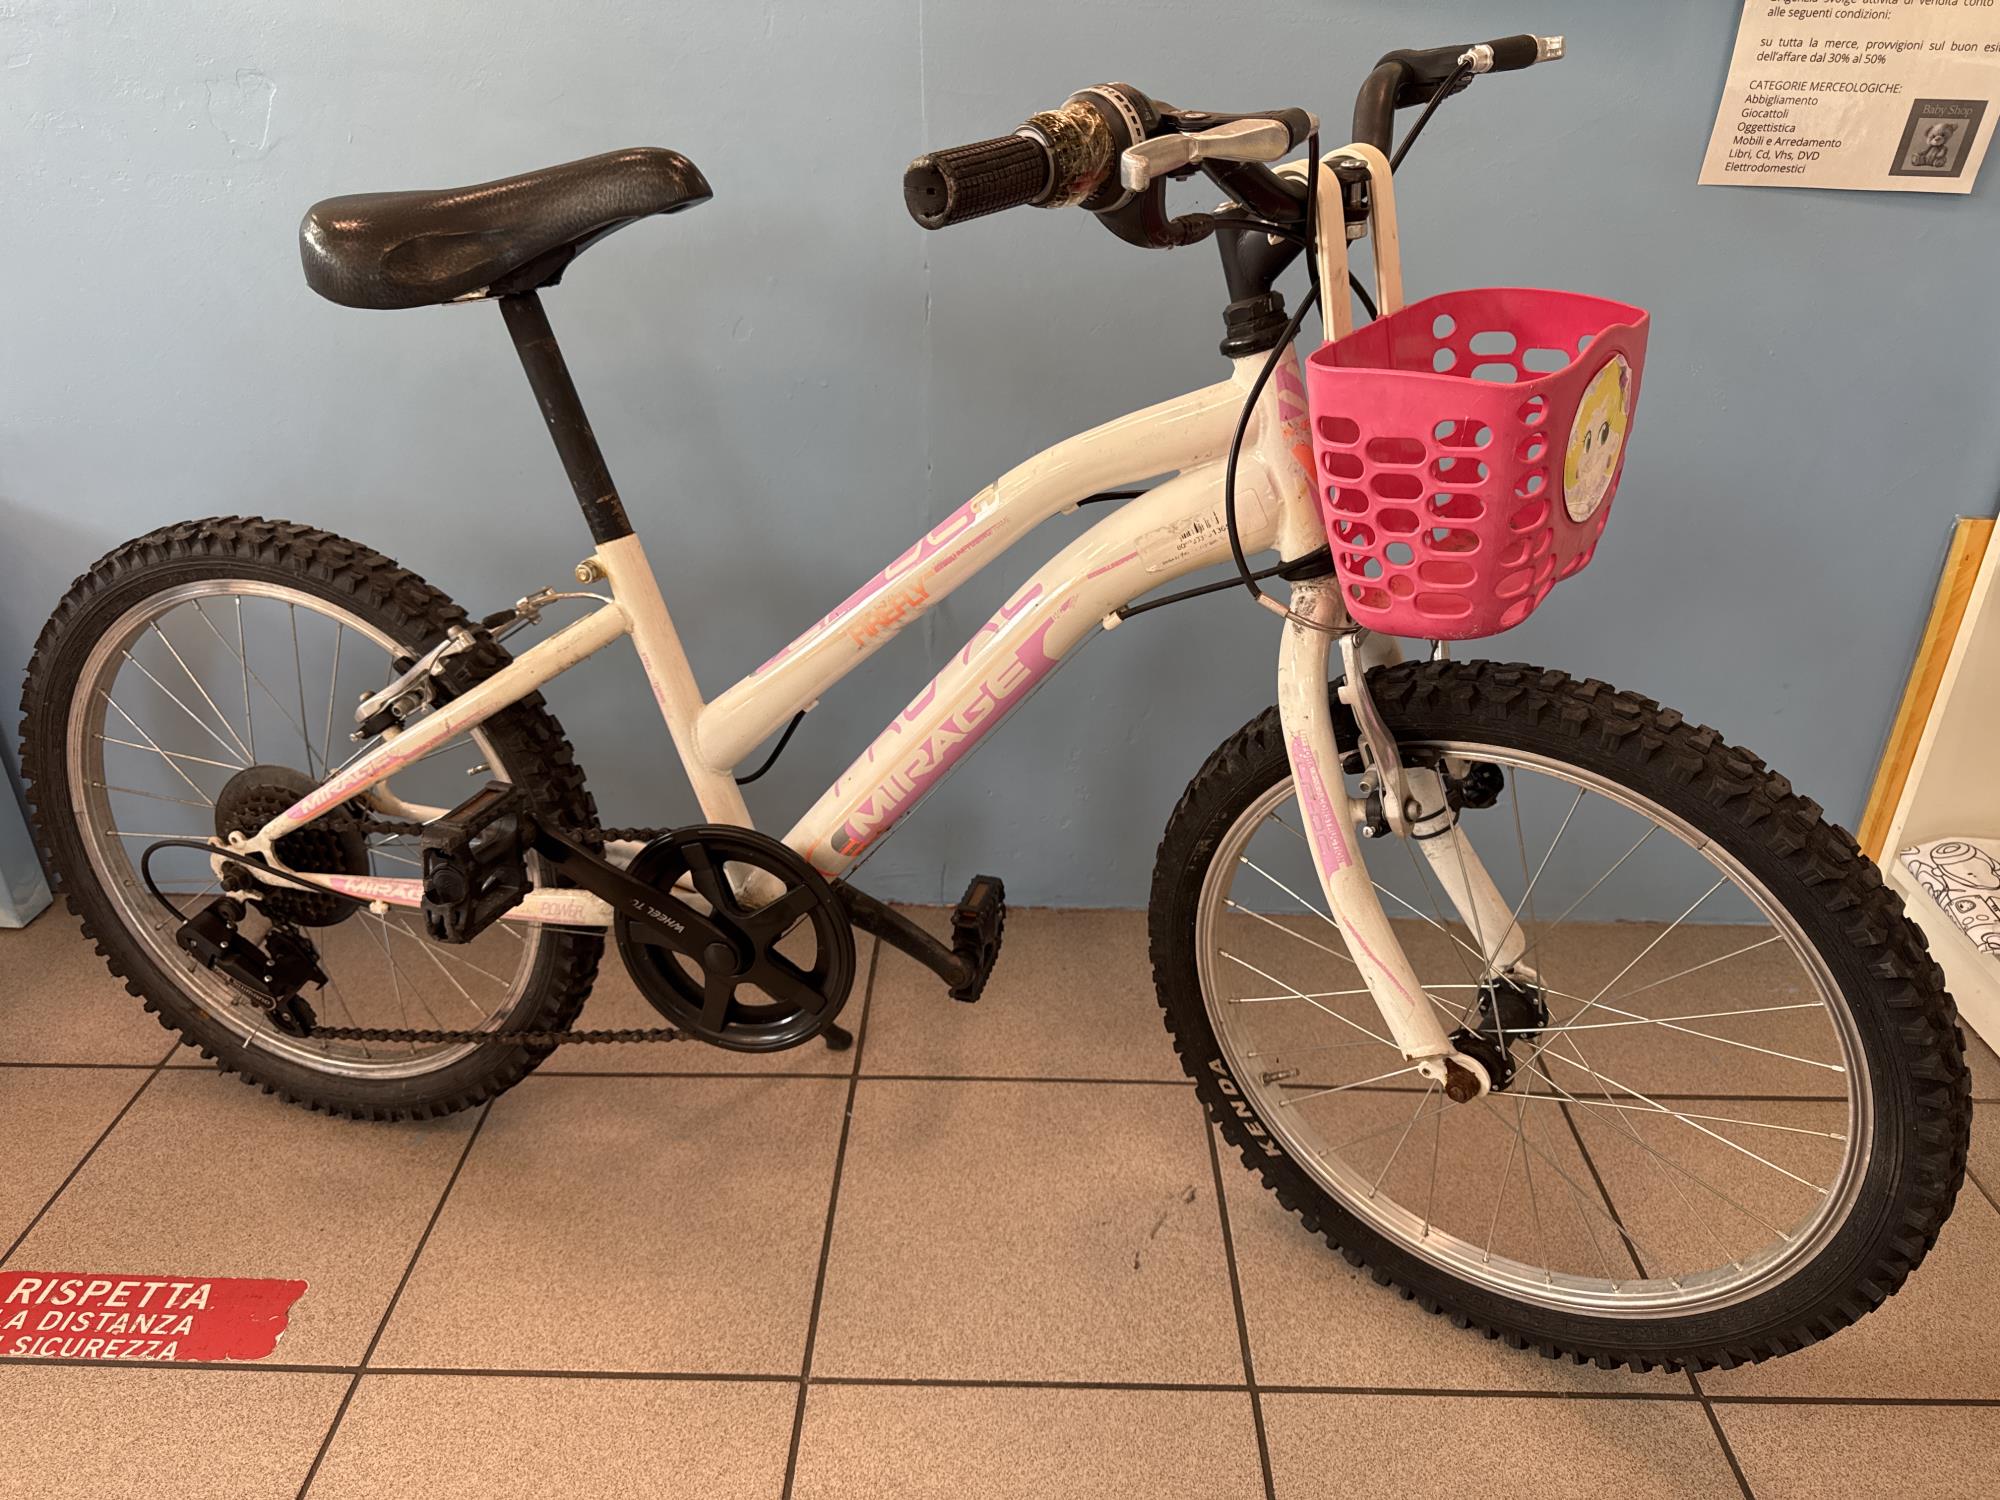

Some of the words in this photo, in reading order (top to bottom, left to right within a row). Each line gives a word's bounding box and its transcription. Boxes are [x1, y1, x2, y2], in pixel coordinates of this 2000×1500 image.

[1767, 6, 1786, 17] alle
[1787, 7, 1833, 20] seguenti
[1834, 9, 1892, 20] condizioni:
[1760, 38, 1773, 47] su
[1778, 38, 1803, 48] tutta
[1809, 37, 1819, 48] la
[1824, 39, 1859, 50] merce,
[1865, 40, 1924, 53] provvigioni
[1929, 41, 1946, 51] sul
[1950, 41, 1978, 51] buon
[1756, 51, 1808, 62] dell'affare
[1809, 52, 1827, 63] dal
[1827, 53, 1850, 64] 30%
[1852, 53, 1863, 64] al
[1863, 54, 1887, 65] 50%
[1749, 80, 1807, 91] CATEGORIE
[1808, 81, 1903, 94] MERCEOLOGICHE:
[1744, 94, 1818, 107] Abbigliamento
[1741, 108, 1789, 119] Giocattoli
[1922, 104, 1946, 117] Baby
[1947, 105, 1973, 118] Shop
[1737, 121, 1796, 134] Oggettistica
[1732, 135, 1765, 146] Mobili
[1765, 138, 1773, 146] e
[1773, 136, 1842, 148] Arredamento
[1728, 149, 1753, 160] Libri,
[1755, 149, 1771, 160] Cd,
[1774, 150, 1794, 161] Vhs,
[1797, 151, 1820, 161] DVD
[1724, 162, 1806, 174] Elettrodomestici
[847, 658, 1032, 837] MIRAGE
[344, 880, 425, 899] MIRAG
[541, 901, 585, 918] POWER
[647, 906, 685, 934] WHEEL
[1208, 1058, 1283, 1158] KENDA
[5, 1278, 212, 1310] RISPETTA
[37, 1311, 194, 1336] DISTANZA
[10, 1335, 178, 1360] SICUREZZA
